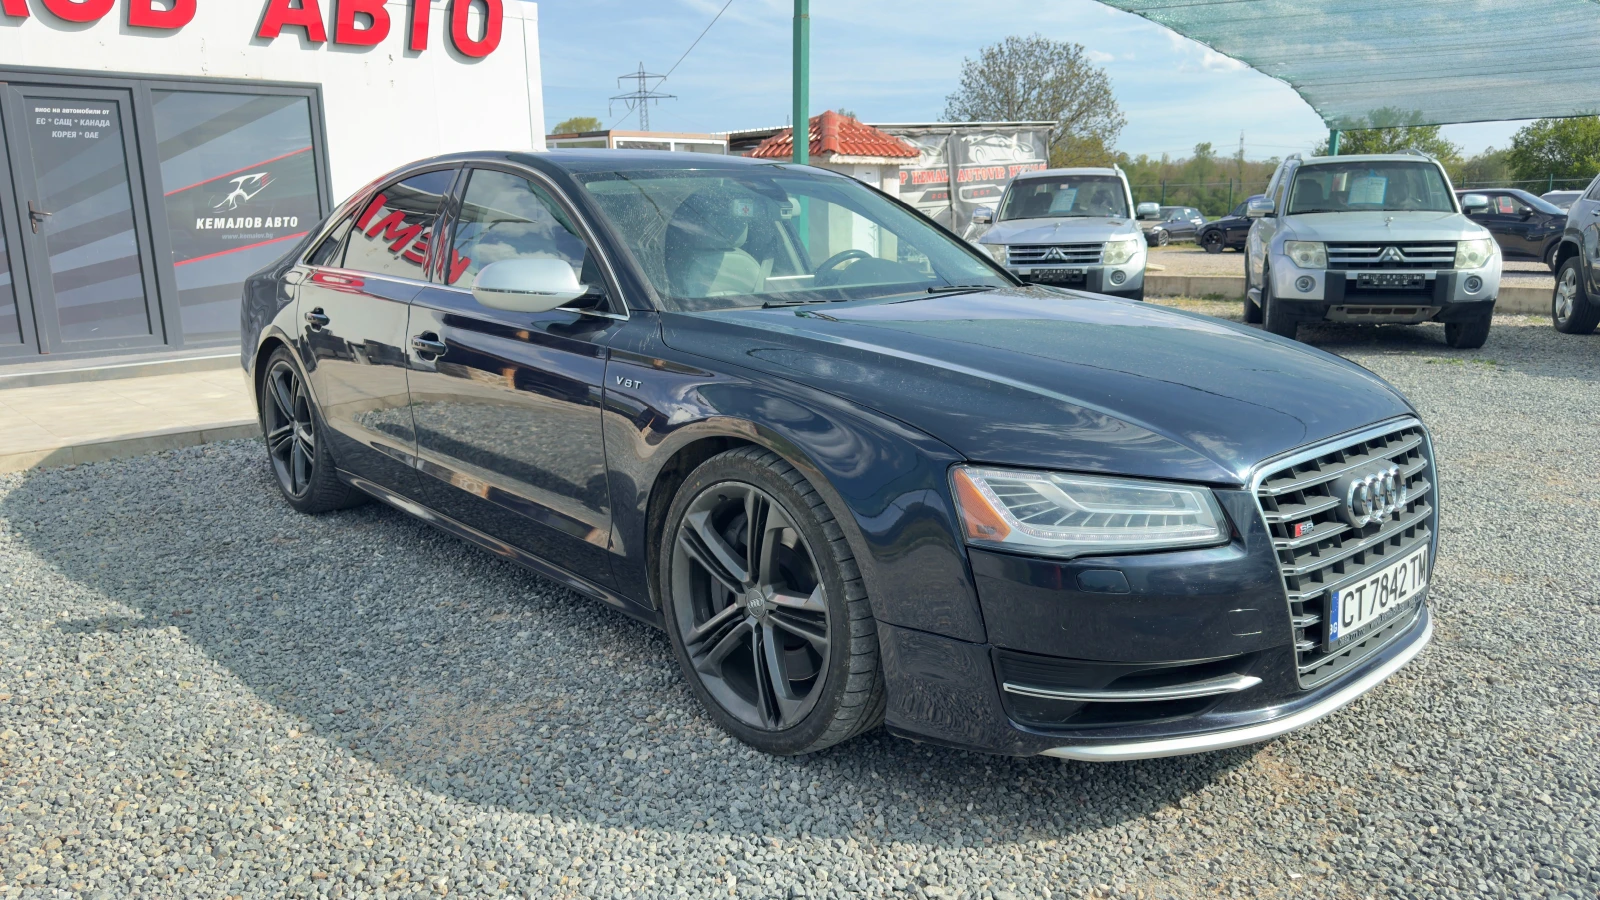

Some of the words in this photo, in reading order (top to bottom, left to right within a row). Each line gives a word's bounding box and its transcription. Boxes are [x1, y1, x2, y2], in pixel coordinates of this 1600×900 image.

[36, 117, 46, 125] ЕС
[54, 118, 72, 127] САЩ
[80, 119, 110, 127] КАНАДА
[84, 131, 99, 139] ОАЕ
[957, 166, 1006, 182] AUTOVIP
[196, 217, 262, 230] КЕМАЛОВ
[264, 216, 299, 228] АВТО
[616, 375, 642, 390] V8T
[1342, 583, 1367, 628] CT
[1369, 562, 1408, 616] 7842
[1410, 549, 1427, 590] TM
